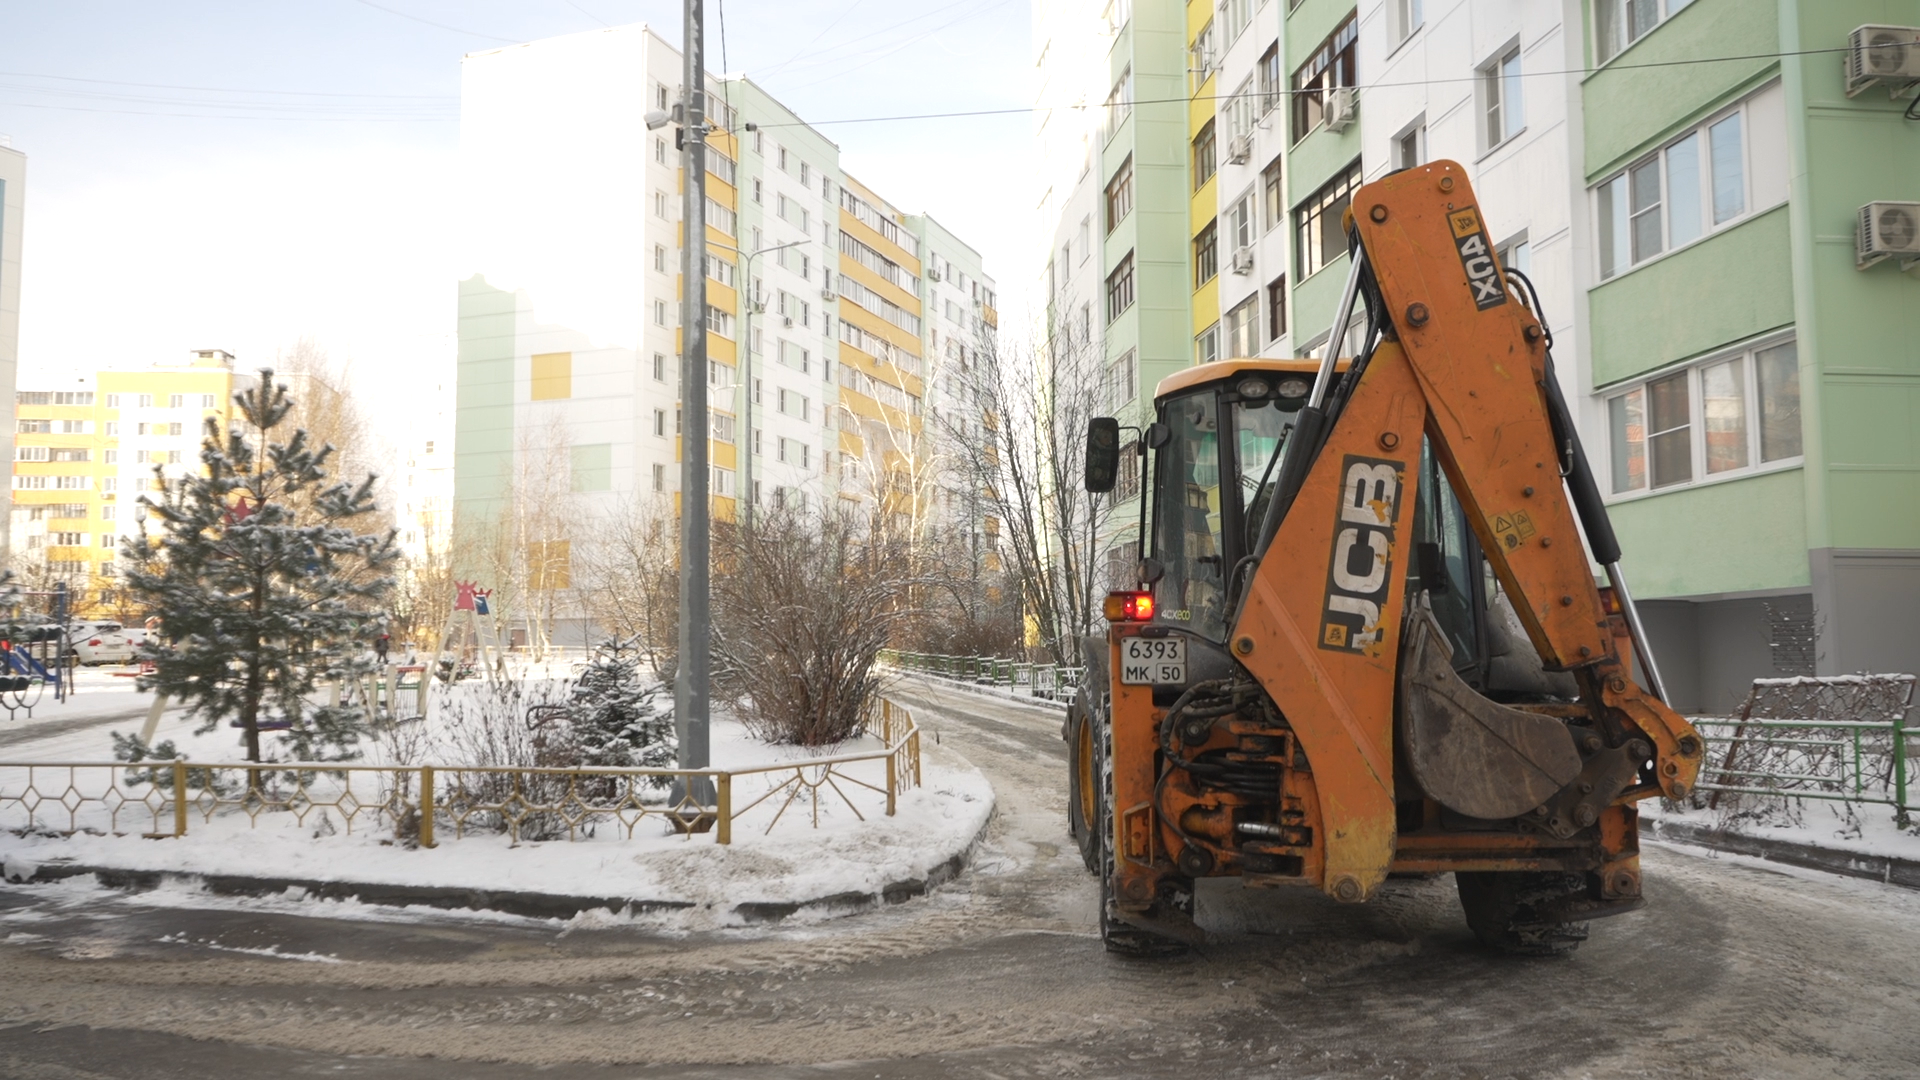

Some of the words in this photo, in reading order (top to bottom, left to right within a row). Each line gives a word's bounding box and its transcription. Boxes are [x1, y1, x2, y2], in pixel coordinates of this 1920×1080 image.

[1460, 234, 1503, 302] 4CX
[1328, 462, 1398, 650] JCB
[1129, 641, 1178, 660] 6393
[1161, 666, 1181, 681] 50
